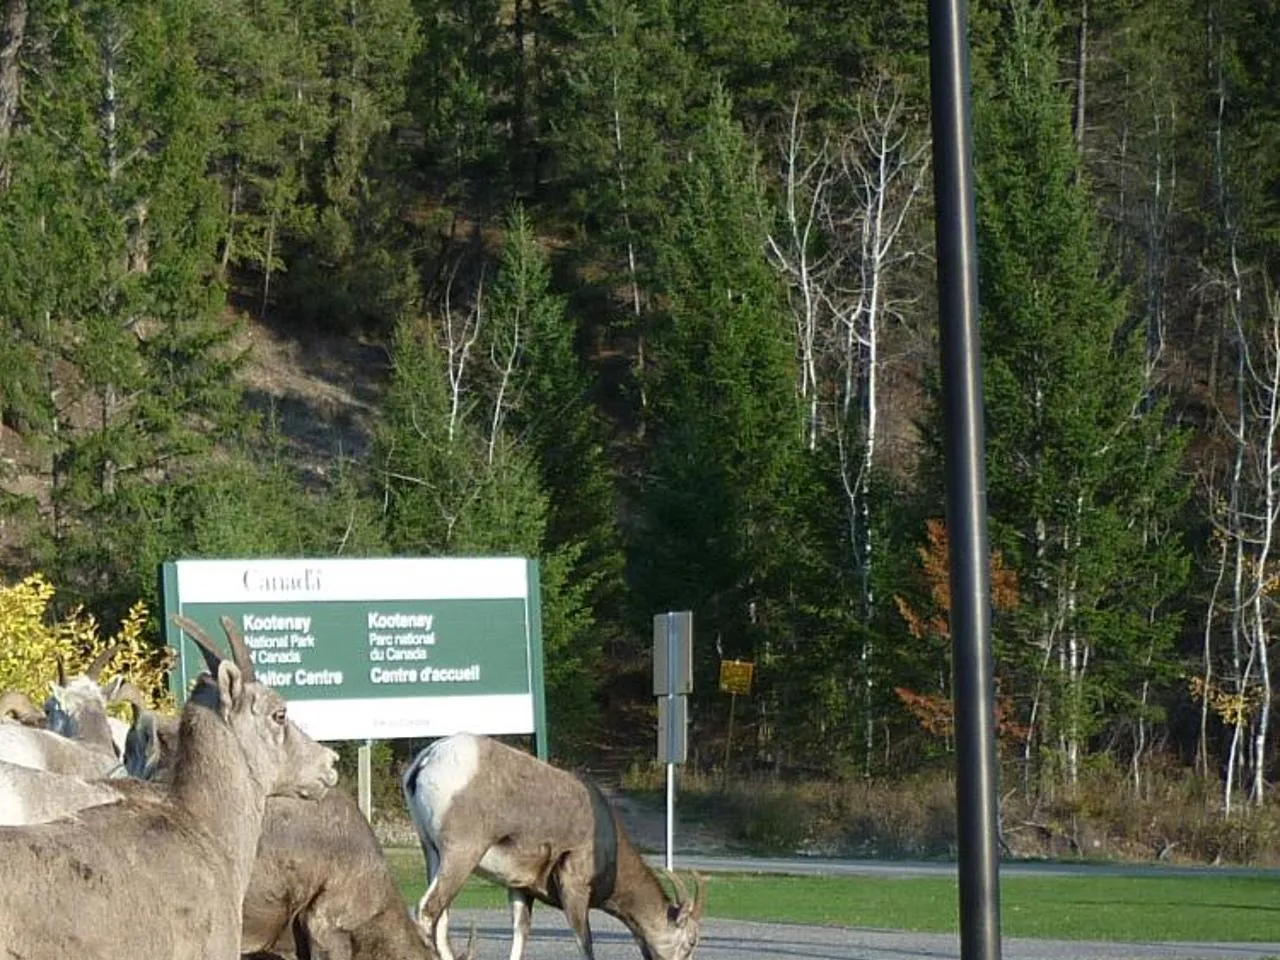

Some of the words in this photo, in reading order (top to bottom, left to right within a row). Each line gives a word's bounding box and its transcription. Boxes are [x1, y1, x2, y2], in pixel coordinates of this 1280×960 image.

[243, 614, 312, 634] Kootenay
[367, 612, 434, 631] Kootenay
[290, 634, 315, 648] Park
[368, 632, 393, 646] Parc
[394, 631, 436, 645] national
[258, 650, 302, 664] Canada
[370, 648, 385, 661] du
[386, 647, 428, 661] Canada
[255, 670, 292, 686] isitor
[295, 669, 343, 686] Centre
[370, 667, 418, 684] Centre
[420, 664, 481, 683] d'accueil
